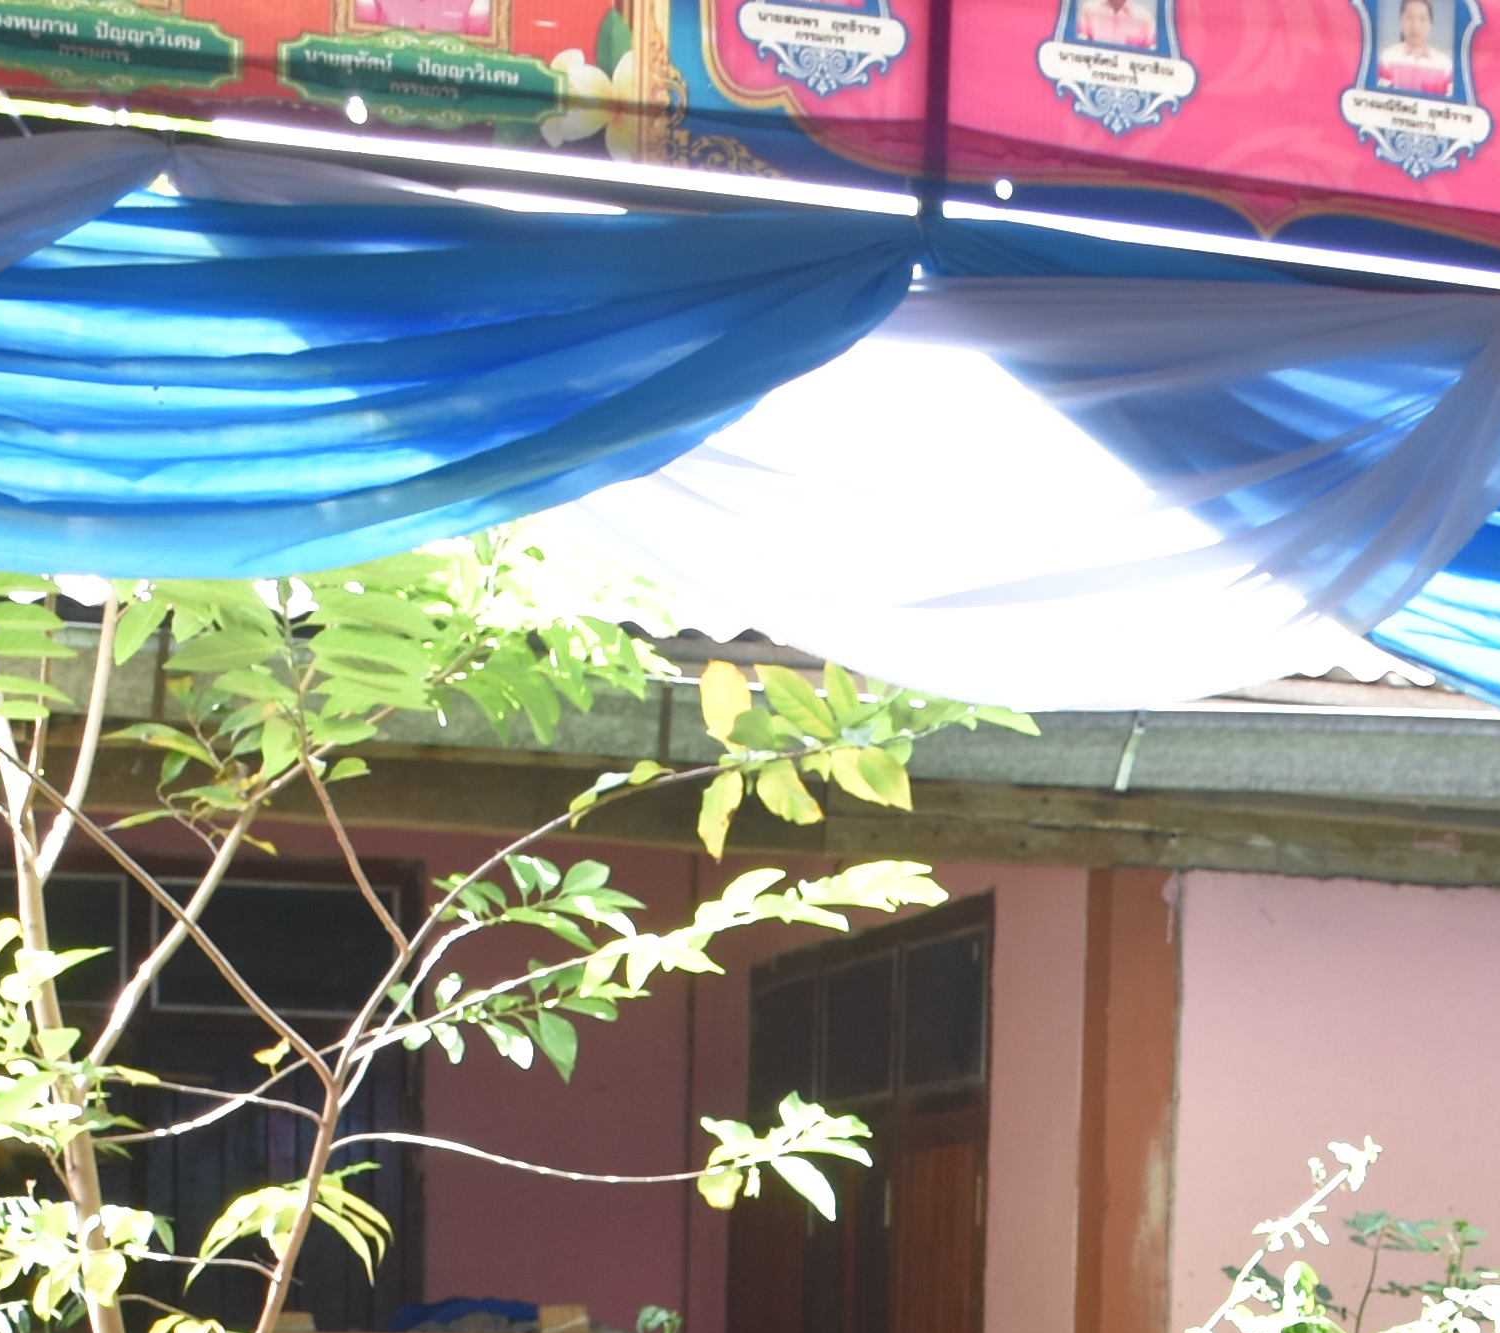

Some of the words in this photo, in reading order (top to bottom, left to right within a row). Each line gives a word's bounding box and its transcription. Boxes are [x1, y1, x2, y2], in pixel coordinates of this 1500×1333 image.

[95, 19, 201, 51] ปัญญาวิเศษ
[59, 42, 130, 63] กรรมการ
[417, 57, 520, 86] ปัญญาวิเศษ
[389, 80, 459, 100] กรรมการ
